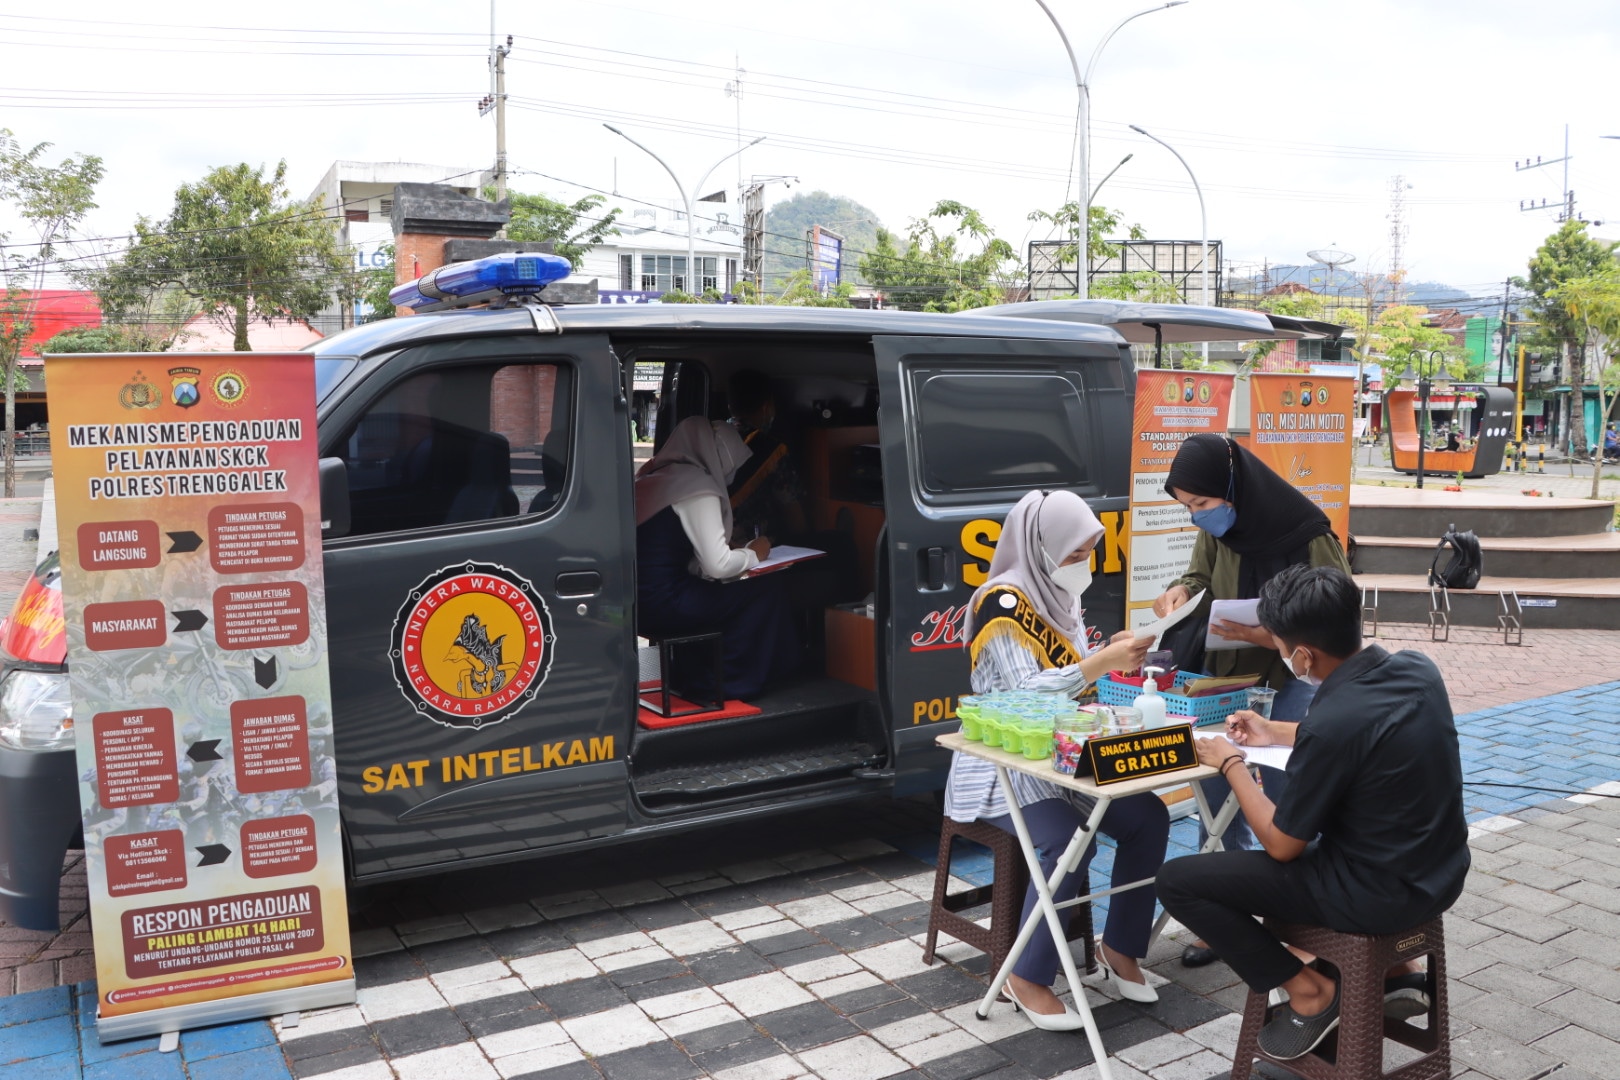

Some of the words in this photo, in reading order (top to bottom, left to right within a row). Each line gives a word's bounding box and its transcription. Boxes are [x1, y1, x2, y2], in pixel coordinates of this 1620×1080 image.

[358, 250, 386, 267] LG
[1257, 413, 1277, 431] VISI,
[1280, 413, 1297, 430] MISI
[1299, 413, 1316, 430] DAN
[1318, 413, 1345, 430] MOTTO
[69, 423, 186, 446] MEKANISME
[190, 420, 300, 444] PENGADUAN
[1141, 432, 1173, 441] STANDAR
[1257, 432, 1285, 442] PELAYANAN
[1152, 442, 1177, 451] POLRES
[107, 449, 217, 472] PELAYANAN
[221, 446, 268, 468] SKCK
[91, 476, 163, 498] POLRES
[168, 472, 286, 495] TRENGGALEK
[225, 512, 257, 522] TINDAKAN
[258, 511, 287, 520] PETUGAS
[99, 529, 139, 544] DATANG
[217, 525, 239, 533] PETUGAS
[93, 547, 147, 562] LANGSUNG
[960, 510, 1130, 588] SK
[230, 590, 262, 601] TINDAKAN
[263, 588, 291, 597] PETUGAS
[408, 581, 461, 639] INDERA
[470, 577, 539, 635] WASPADA
[92, 617, 158, 634] MASYARAKAT
[410, 663, 462, 713] NEGARA
[474, 659, 537, 713] RAHARJA
[123, 715, 144, 726] KASAT
[243, 716, 273, 727] JAWABAN
[273, 713, 296, 724] DUMAS
[1099, 741, 1132, 758] SNACK
[1134, 740, 1141, 752] &
[1142, 732, 1185, 750] MINUMAN
[362, 759, 430, 794] SAT
[442, 735, 615, 783] INTELKAM
[1114, 749, 1178, 773] GRATIS
[130, 837, 158, 849] KASAT
[248, 830, 280, 842] TINDAKAN
[280, 827, 308, 837] PETUGAS
[130, 850, 153, 858] Hotline
[153, 848, 168, 856] Skck
[136, 872, 155, 880] Email
[132, 907, 203, 936] RESPON
[208, 891, 311, 925] PENGADUAN
[147, 934, 195, 951] PALING
[199, 924, 249, 945] LAMBAT
[252, 922, 267, 936] 14
[270, 917, 301, 933] HARI
[133, 951, 170, 964] MENURUT
[170, 940, 234, 959] UNDANG-UNDANG
[235, 937, 261, 950] NOMOR
[262, 935, 272, 946] 25
[272, 931, 296, 944] TAHUN
[297, 928, 315, 940] 2007
[158, 957, 191, 970] TENTANG
[192, 951, 234, 965] PELAYANAN
[235, 946, 261, 958] PUBLIK
[262, 943, 284, 954] PASAL
[284, 941, 294, 951] 44
